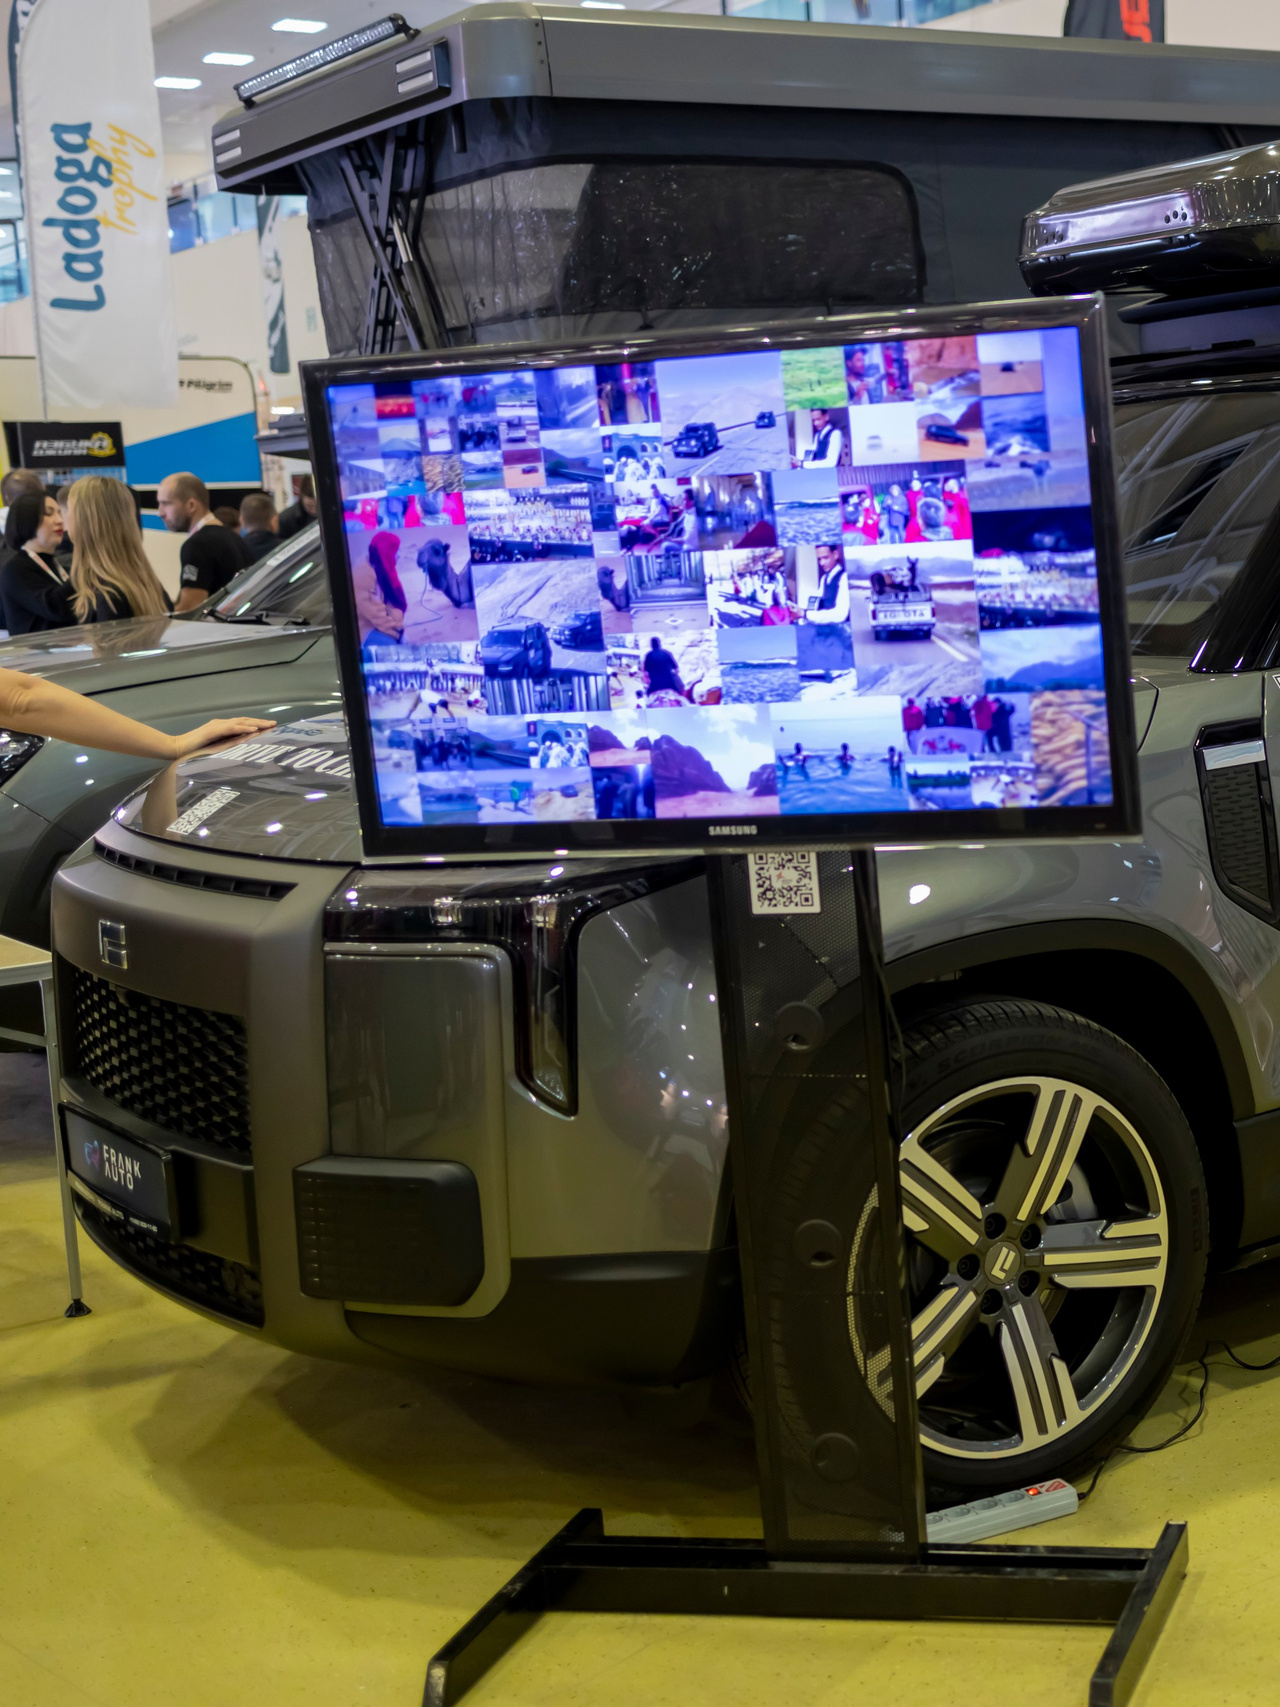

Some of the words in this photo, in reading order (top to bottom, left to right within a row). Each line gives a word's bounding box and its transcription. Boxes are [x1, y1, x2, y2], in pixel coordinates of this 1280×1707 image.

[42, 121, 114, 311] Ladoga
[277, 747, 334, 769] TO
[708, 824, 758, 836] SAMSUNG
[102, 1144, 141, 1179] FRANK
[105, 1161, 134, 1190] AUTO
